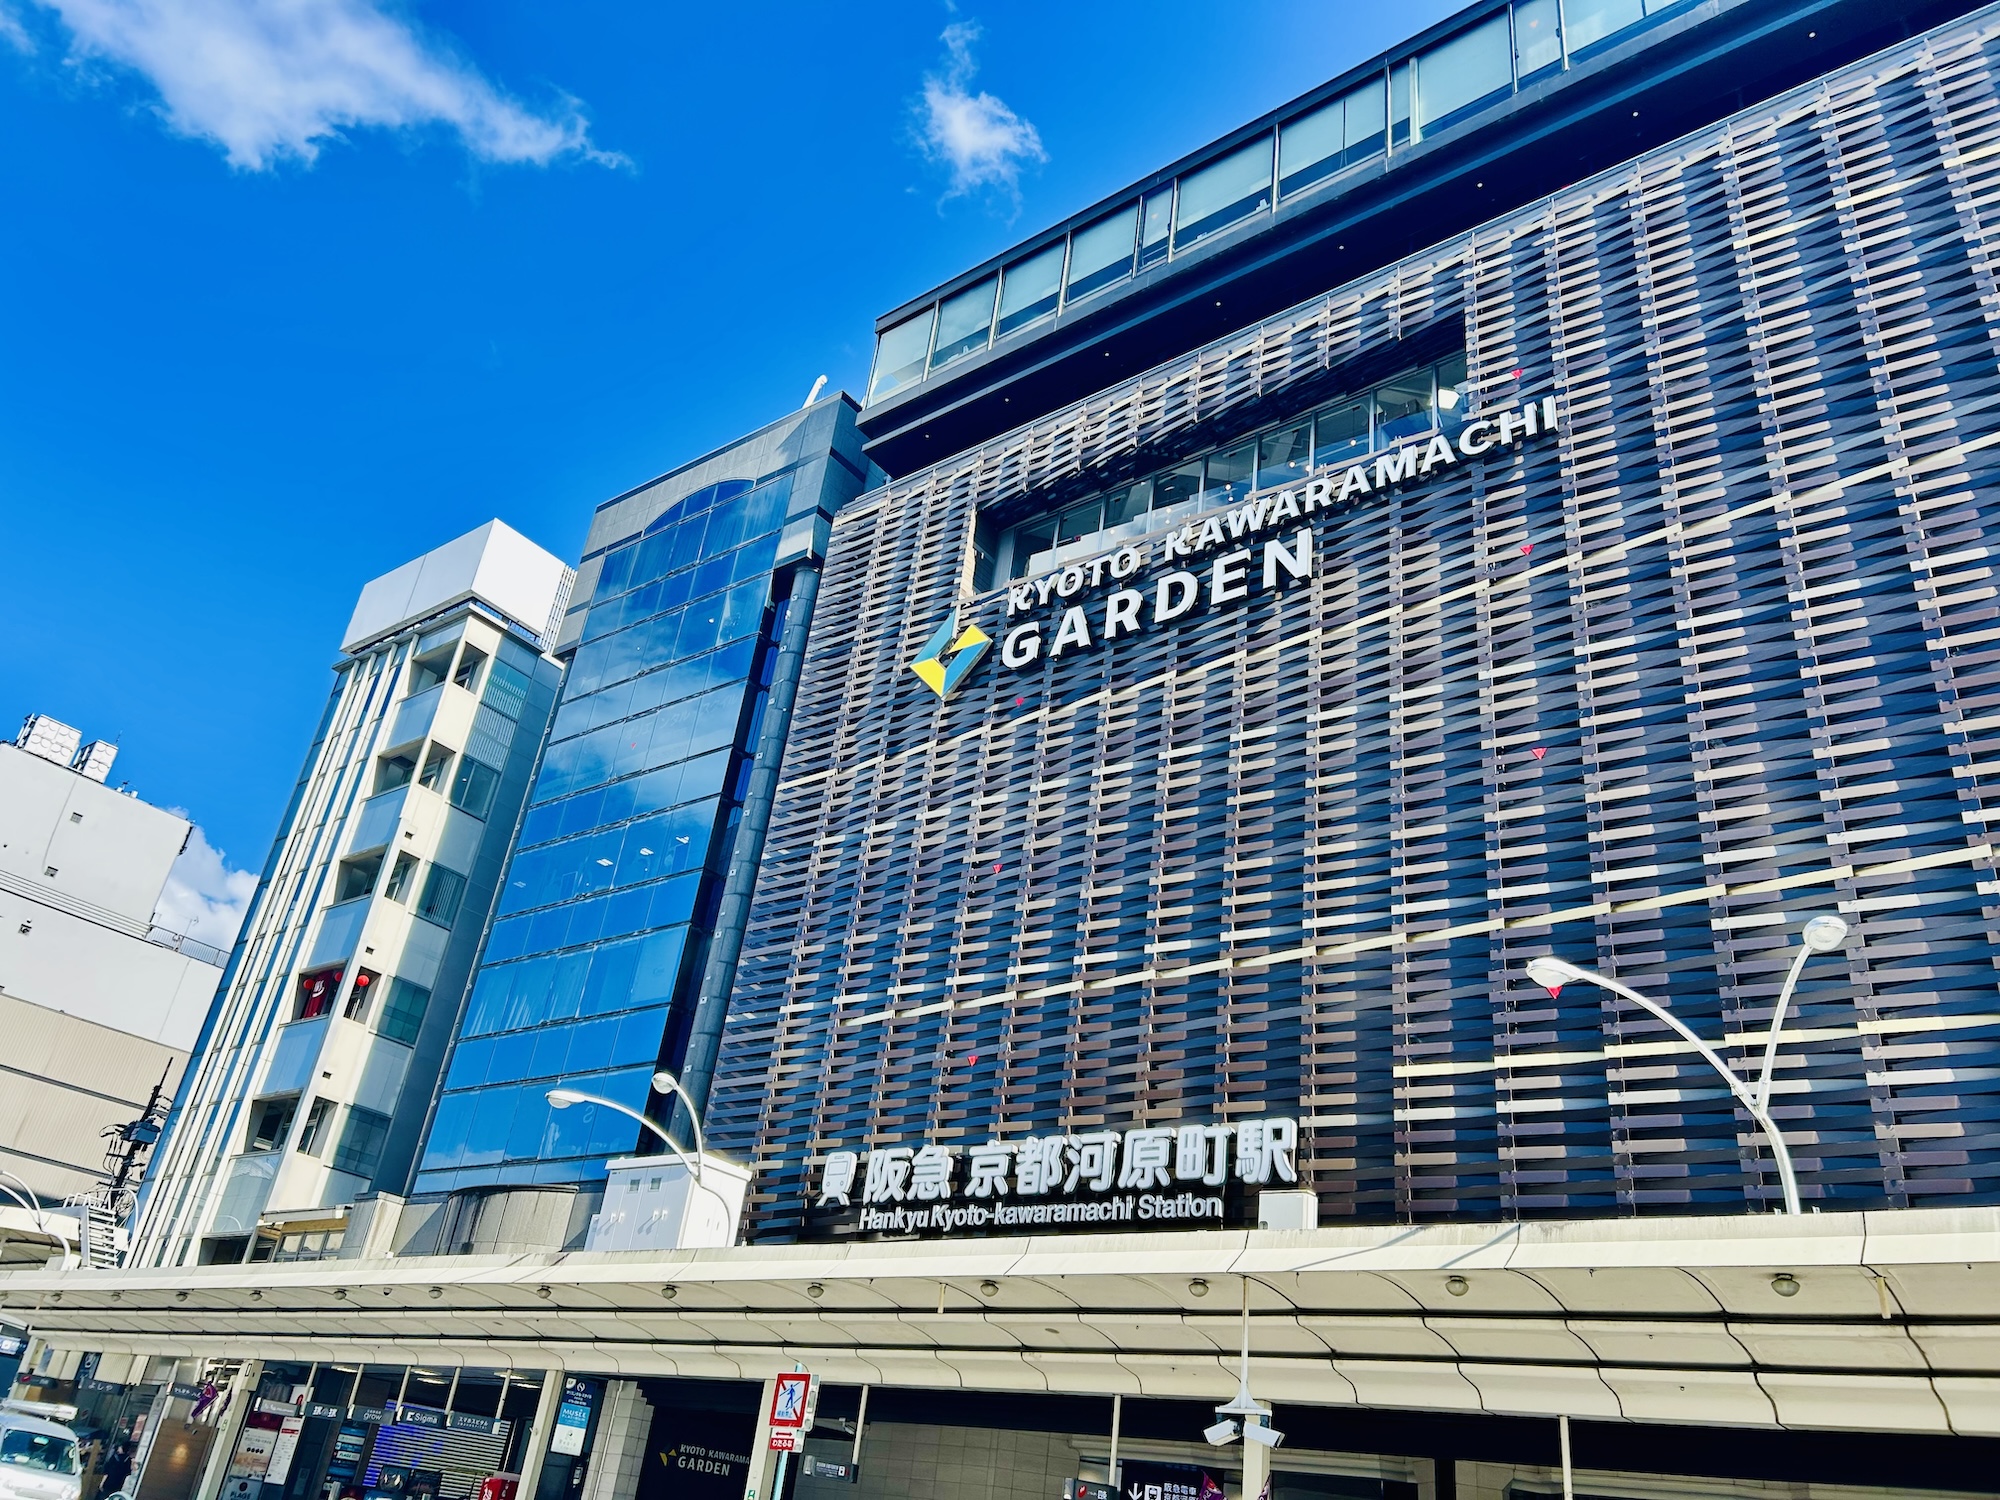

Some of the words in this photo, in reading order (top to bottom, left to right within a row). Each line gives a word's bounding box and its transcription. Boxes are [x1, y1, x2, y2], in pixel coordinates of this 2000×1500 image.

[1006, 546, 1141, 619] KYOTO
[1164, 394, 1560, 562] KAWARAMACHI
[1001, 528, 1316, 671] GARDEN
[861, 1144, 954, 1204] 阪急
[963, 1117, 1299, 1199] 京都河原町駅
[858, 1206, 929, 1233] Hankyu
[930, 1194, 1135, 1233] Kyoto-kawaramachi
[1138, 1191, 1224, 1220] Station
[363, 1413, 383, 1421] grow
[414, 1413, 438, 1424] Sigma
[680, 1444, 706, 1457] KYOTO
[708, 1450, 750, 1465] KAWARAMA
[677, 1456, 730, 1476] GARDEN
[1163, 1482, 1197, 1496] 阪急電車
